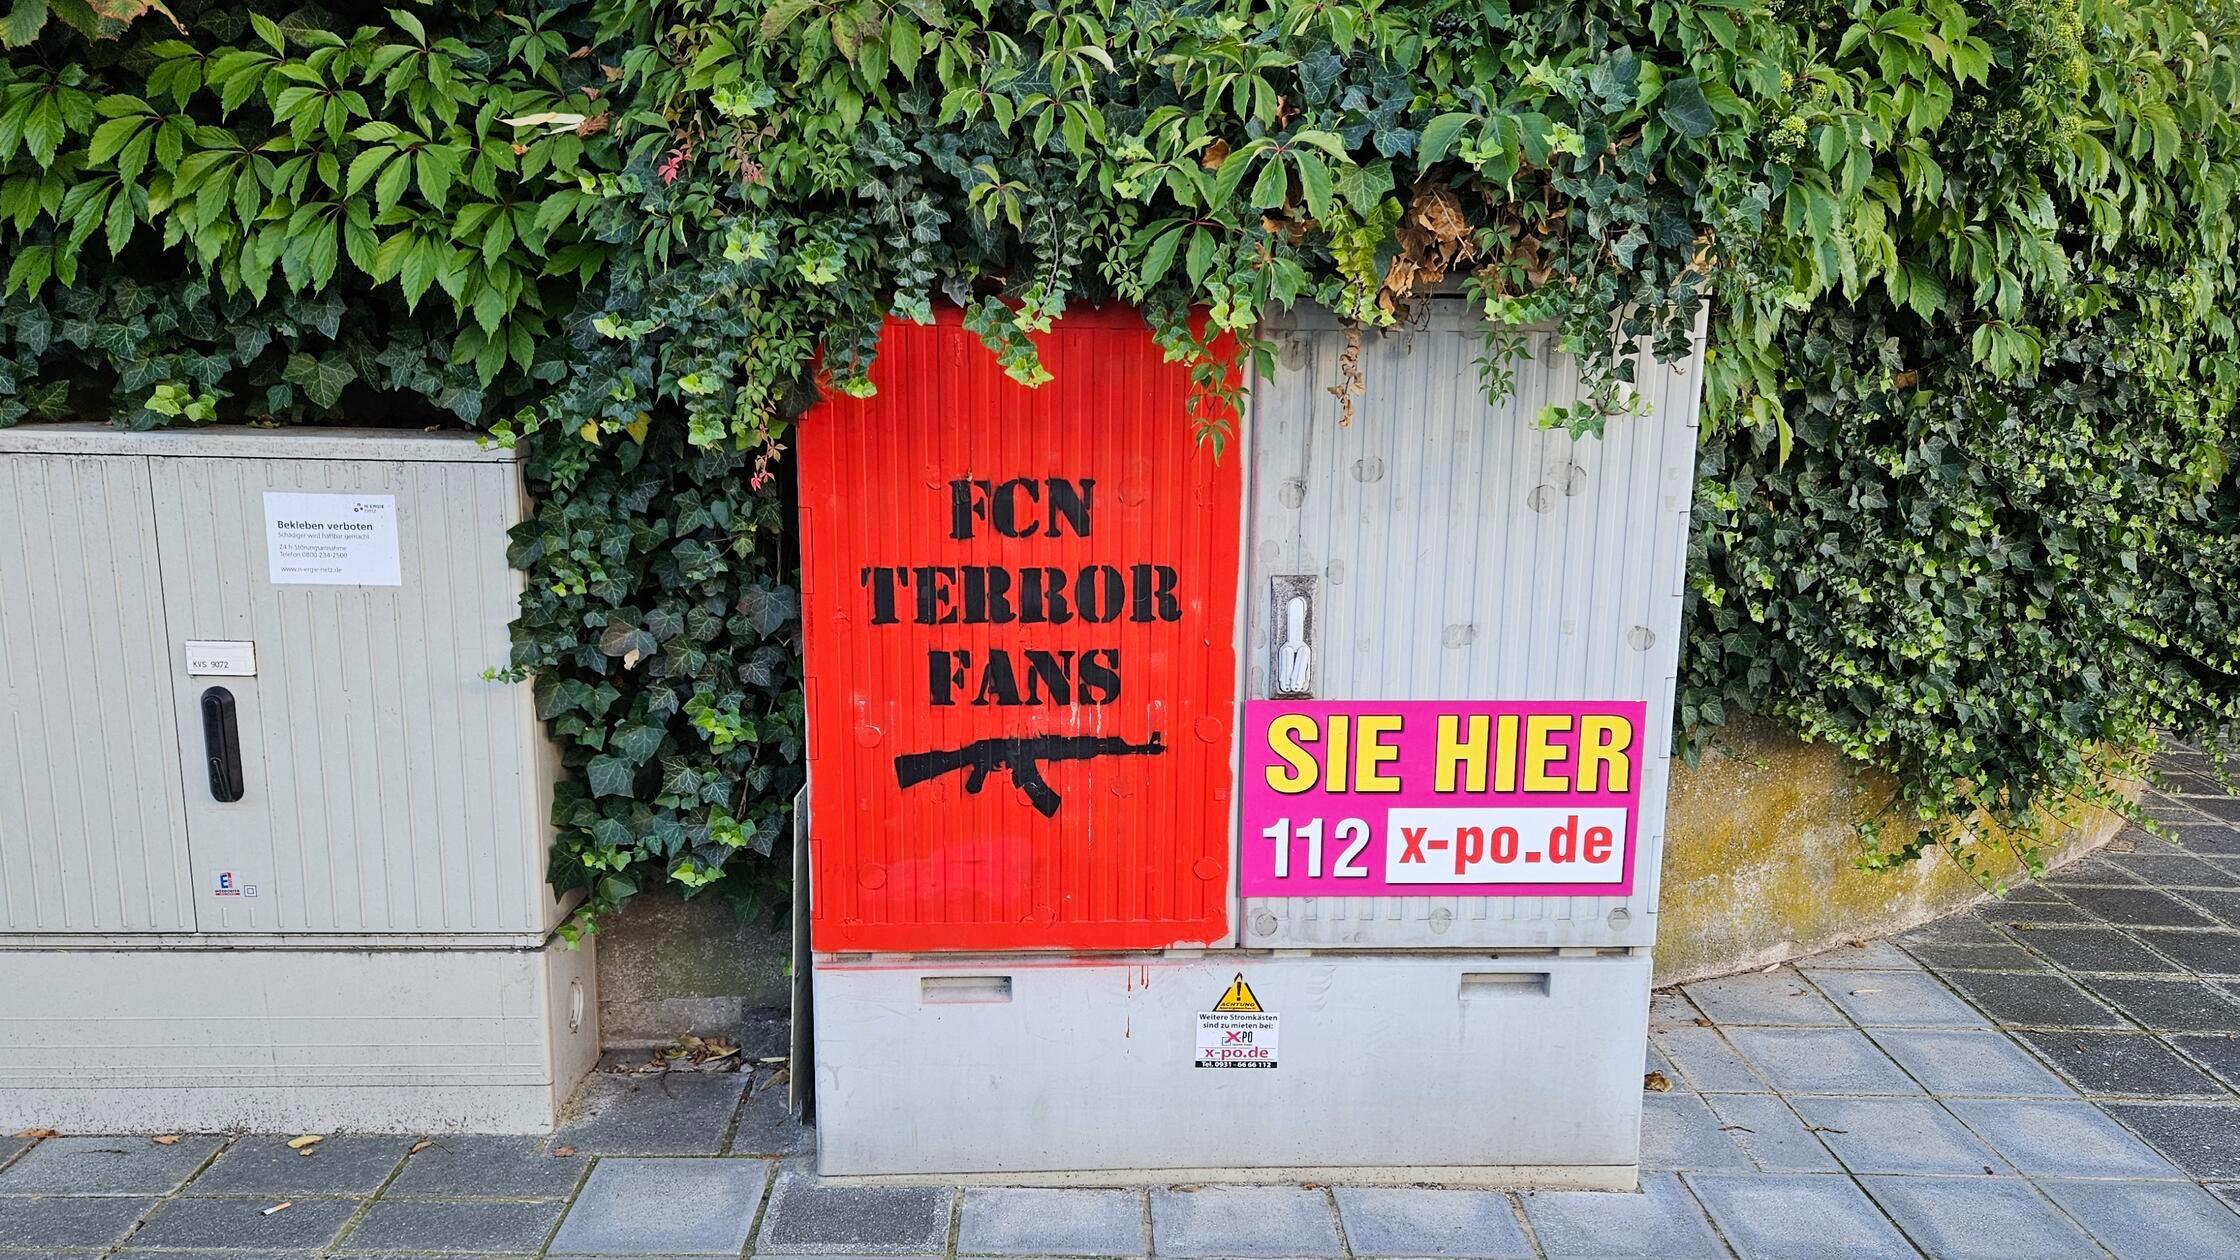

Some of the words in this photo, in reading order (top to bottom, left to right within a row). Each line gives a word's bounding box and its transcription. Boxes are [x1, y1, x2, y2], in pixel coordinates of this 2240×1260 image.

[277, 520, 324, 530] Bekleben
[327, 522, 373, 531] verboten
[278, 532, 306, 540] Schädiger
[321, 532, 343, 540] haftbar
[948, 477, 1096, 540] FCN
[861, 563, 1182, 624] TERROR
[929, 649, 1122, 706] FANS
[1265, 713, 1403, 794] SIE
[1433, 713, 1633, 794] HIER
[1262, 817, 1371, 878] 112
[1399, 814, 1613, 876] x-po.de
[1205, 1046, 1269, 1060] x-po.de
